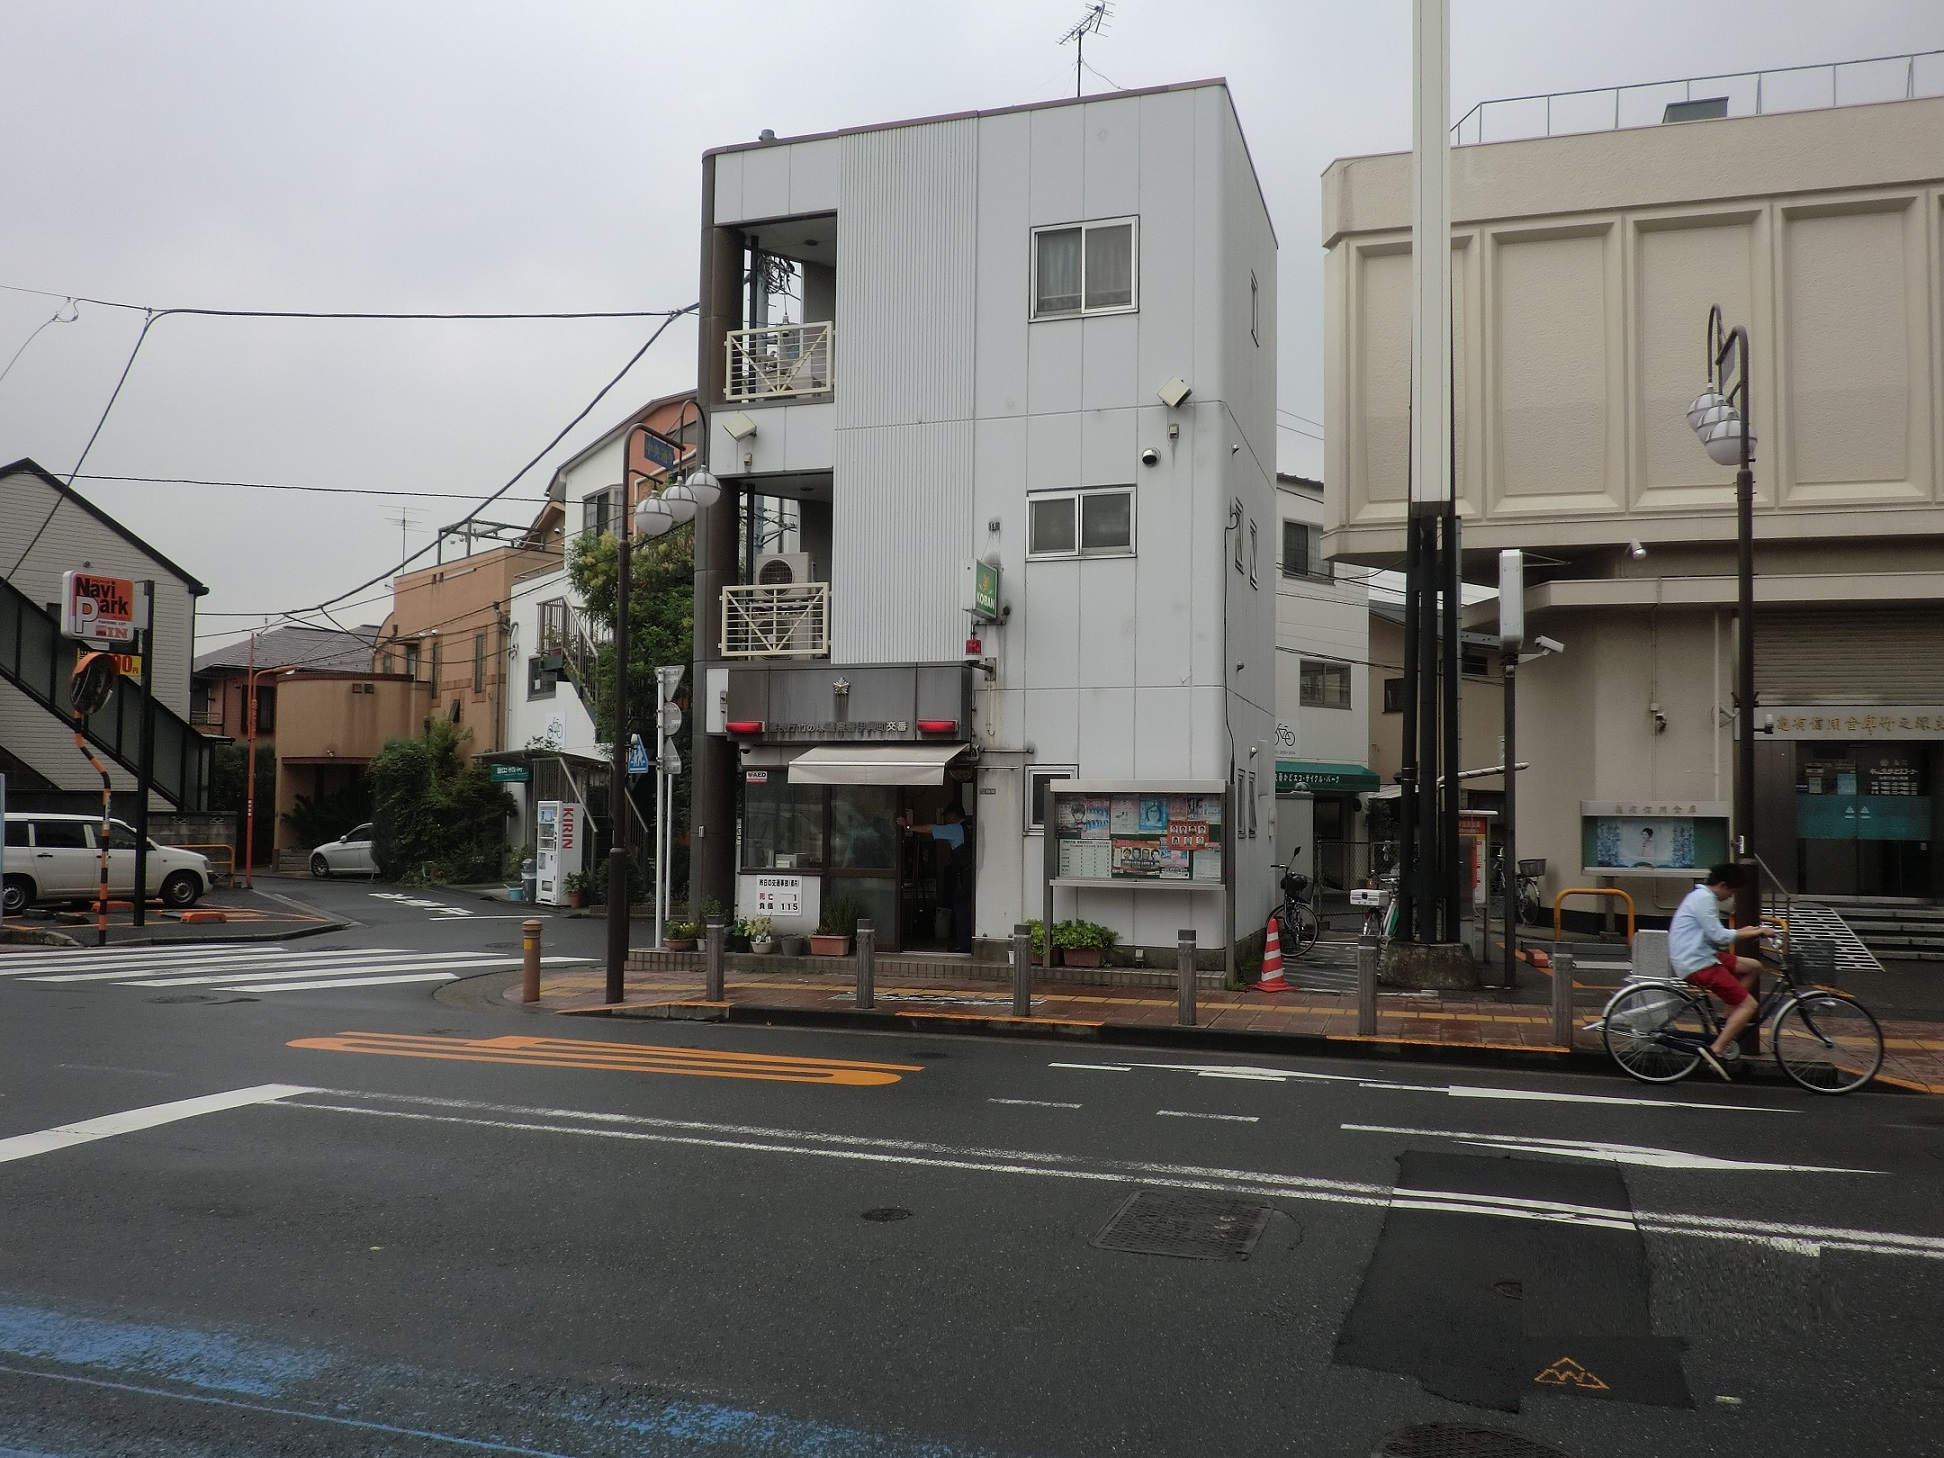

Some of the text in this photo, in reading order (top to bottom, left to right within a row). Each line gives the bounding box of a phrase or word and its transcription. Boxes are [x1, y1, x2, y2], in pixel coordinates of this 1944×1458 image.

[76, 577, 116, 598] Navi
[976, 592, 995, 609] KOBAN
[75, 596, 129, 634] Park
[562, 807, 574, 850] KIRIN
[781, 903, 798, 911] 115
[285, 1031, 925, 1086] 40
